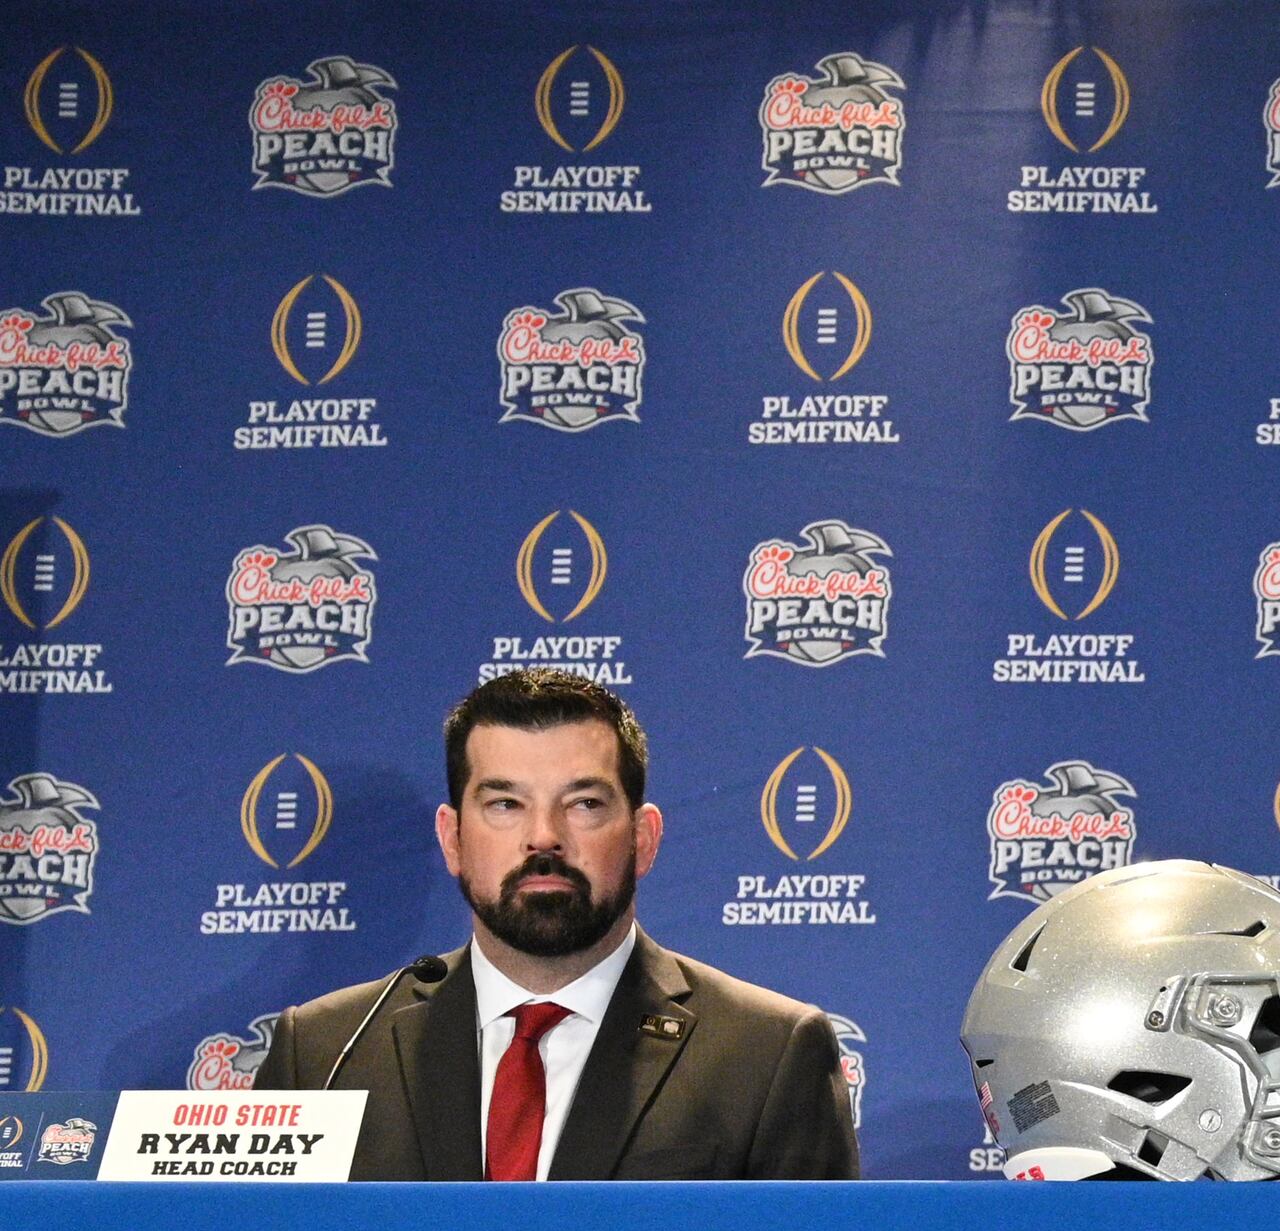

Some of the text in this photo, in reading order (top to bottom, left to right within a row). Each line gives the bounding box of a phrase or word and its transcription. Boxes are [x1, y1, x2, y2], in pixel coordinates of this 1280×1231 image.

[258, 131, 389, 167] PEACH
[768, 130, 897, 163] PEACH
[284, 159, 362, 174] BOWL
[794, 157, 870, 170] BOWL
[3, 167, 129, 190] PLAYOFF
[513, 165, 641, 188] PLAYOFF
[1020, 166, 1146, 188] PLAYOFF
[500, 189, 653, 214] SEMIFINAL
[1007, 190, 1158, 213] SEMIFINAL
[506, 366, 637, 398] PEACH
[1016, 366, 1145, 397] PEACH
[17, 398, 95, 411] BOWL
[247, 397, 377, 424] PLAYOFF
[532, 394, 610, 406] BOWL
[762, 394, 888, 419] PLAYOFF
[1042, 393, 1119, 405] BOWL
[234, 422, 389, 451] SEMIFINAL
[748, 419, 900, 445] SEMIFINAL
[233, 604, 367, 640] PEACH
[751, 600, 883, 633] PEACH
[260, 633, 339, 648] BOWL
[492, 635, 622, 658] PLAYOFF
[777, 628, 855, 641] BOWL
[1006, 633, 1134, 657] PLAYOFF
[993, 659, 1146, 683] SEMIFINAL
[215, 880, 346, 908] PLAYOFF
[736, 873, 866, 899] PLAYOFF
[200, 906, 358, 936] SEMIFINAL
[722, 899, 877, 926] SEMIFINAL
[173, 1104, 301, 1126] OHIO STATE
[42, 1143, 90, 1153] PEACH
[137, 1134, 324, 1154] RYAN DAY
[151, 1161, 297, 1175] HEAD COACH
